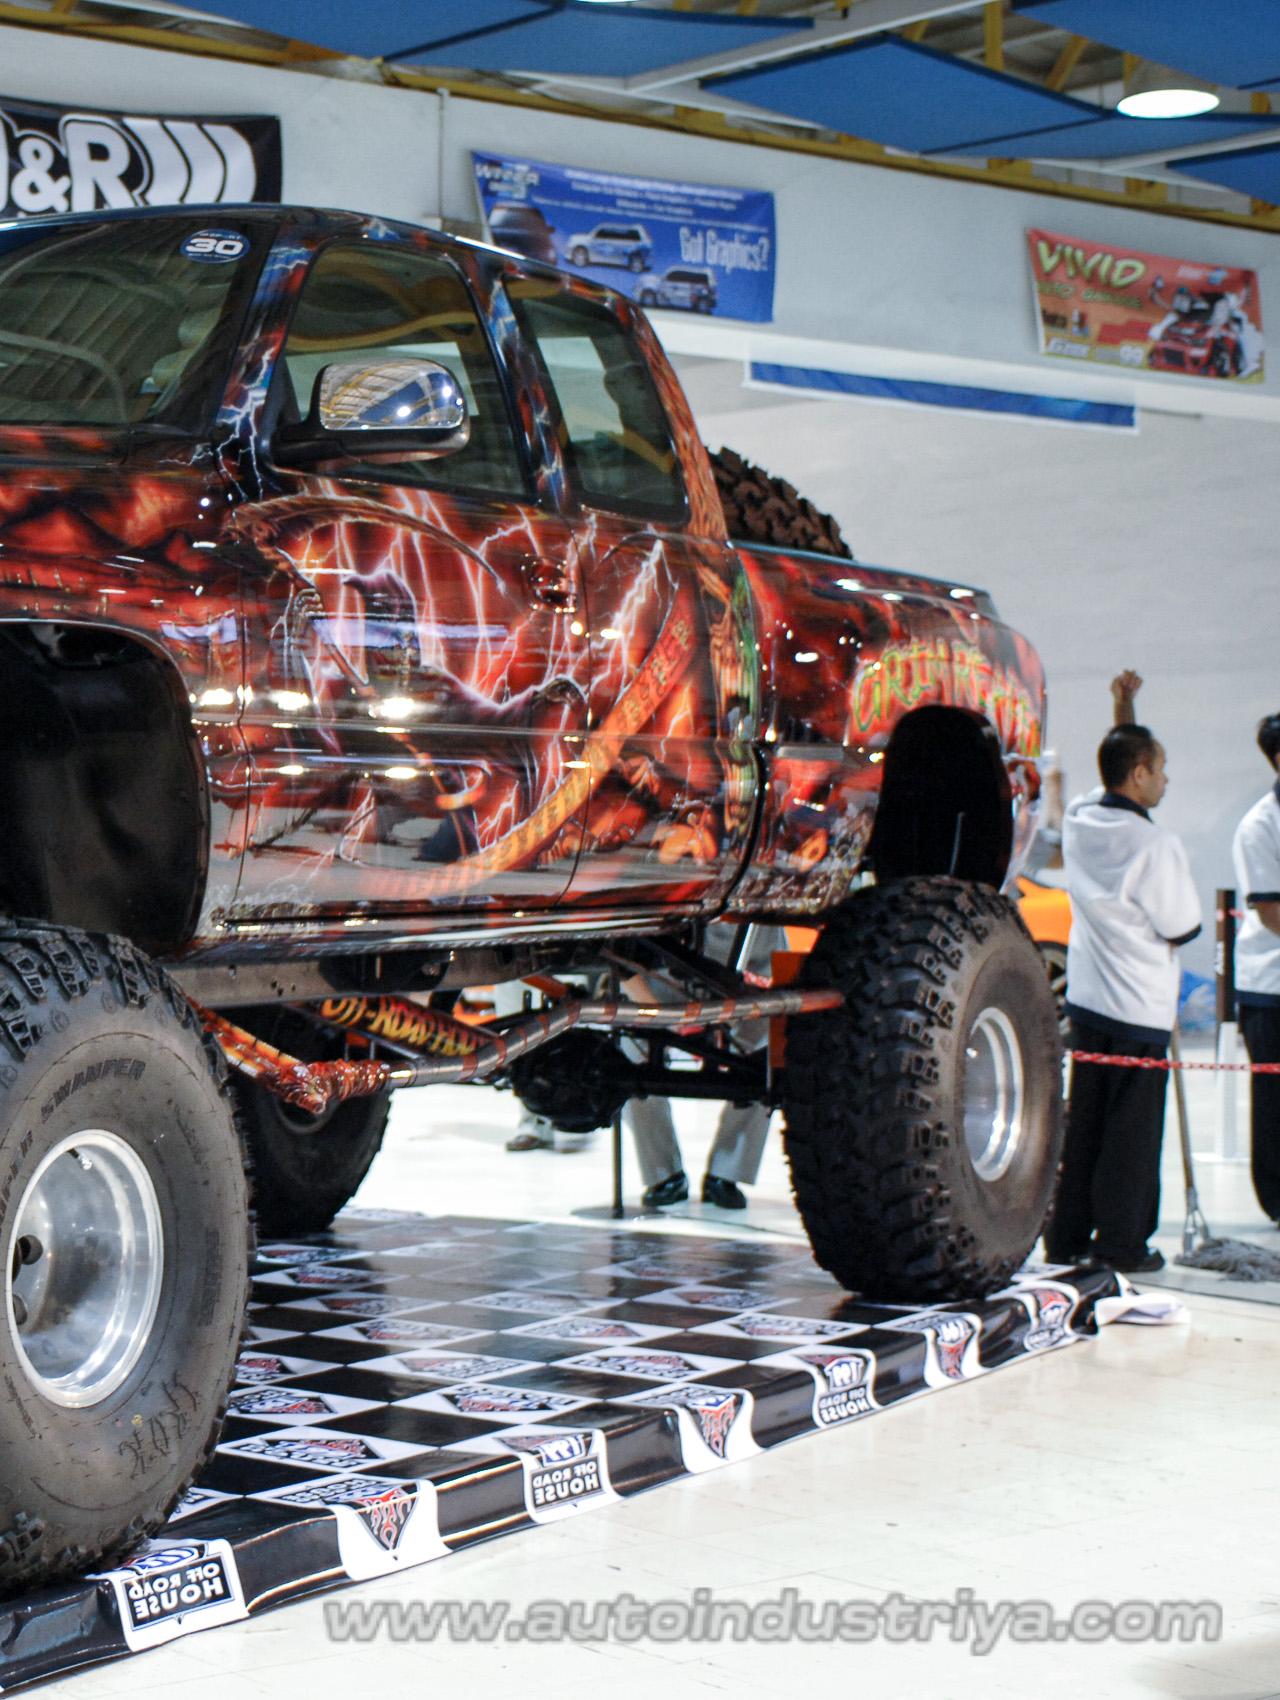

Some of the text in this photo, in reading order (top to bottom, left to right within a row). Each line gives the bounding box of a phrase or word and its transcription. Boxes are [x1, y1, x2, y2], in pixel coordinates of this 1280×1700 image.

[679, 226, 770, 274] Got Graphics?
[1037, 240, 1145, 288] VIVID
